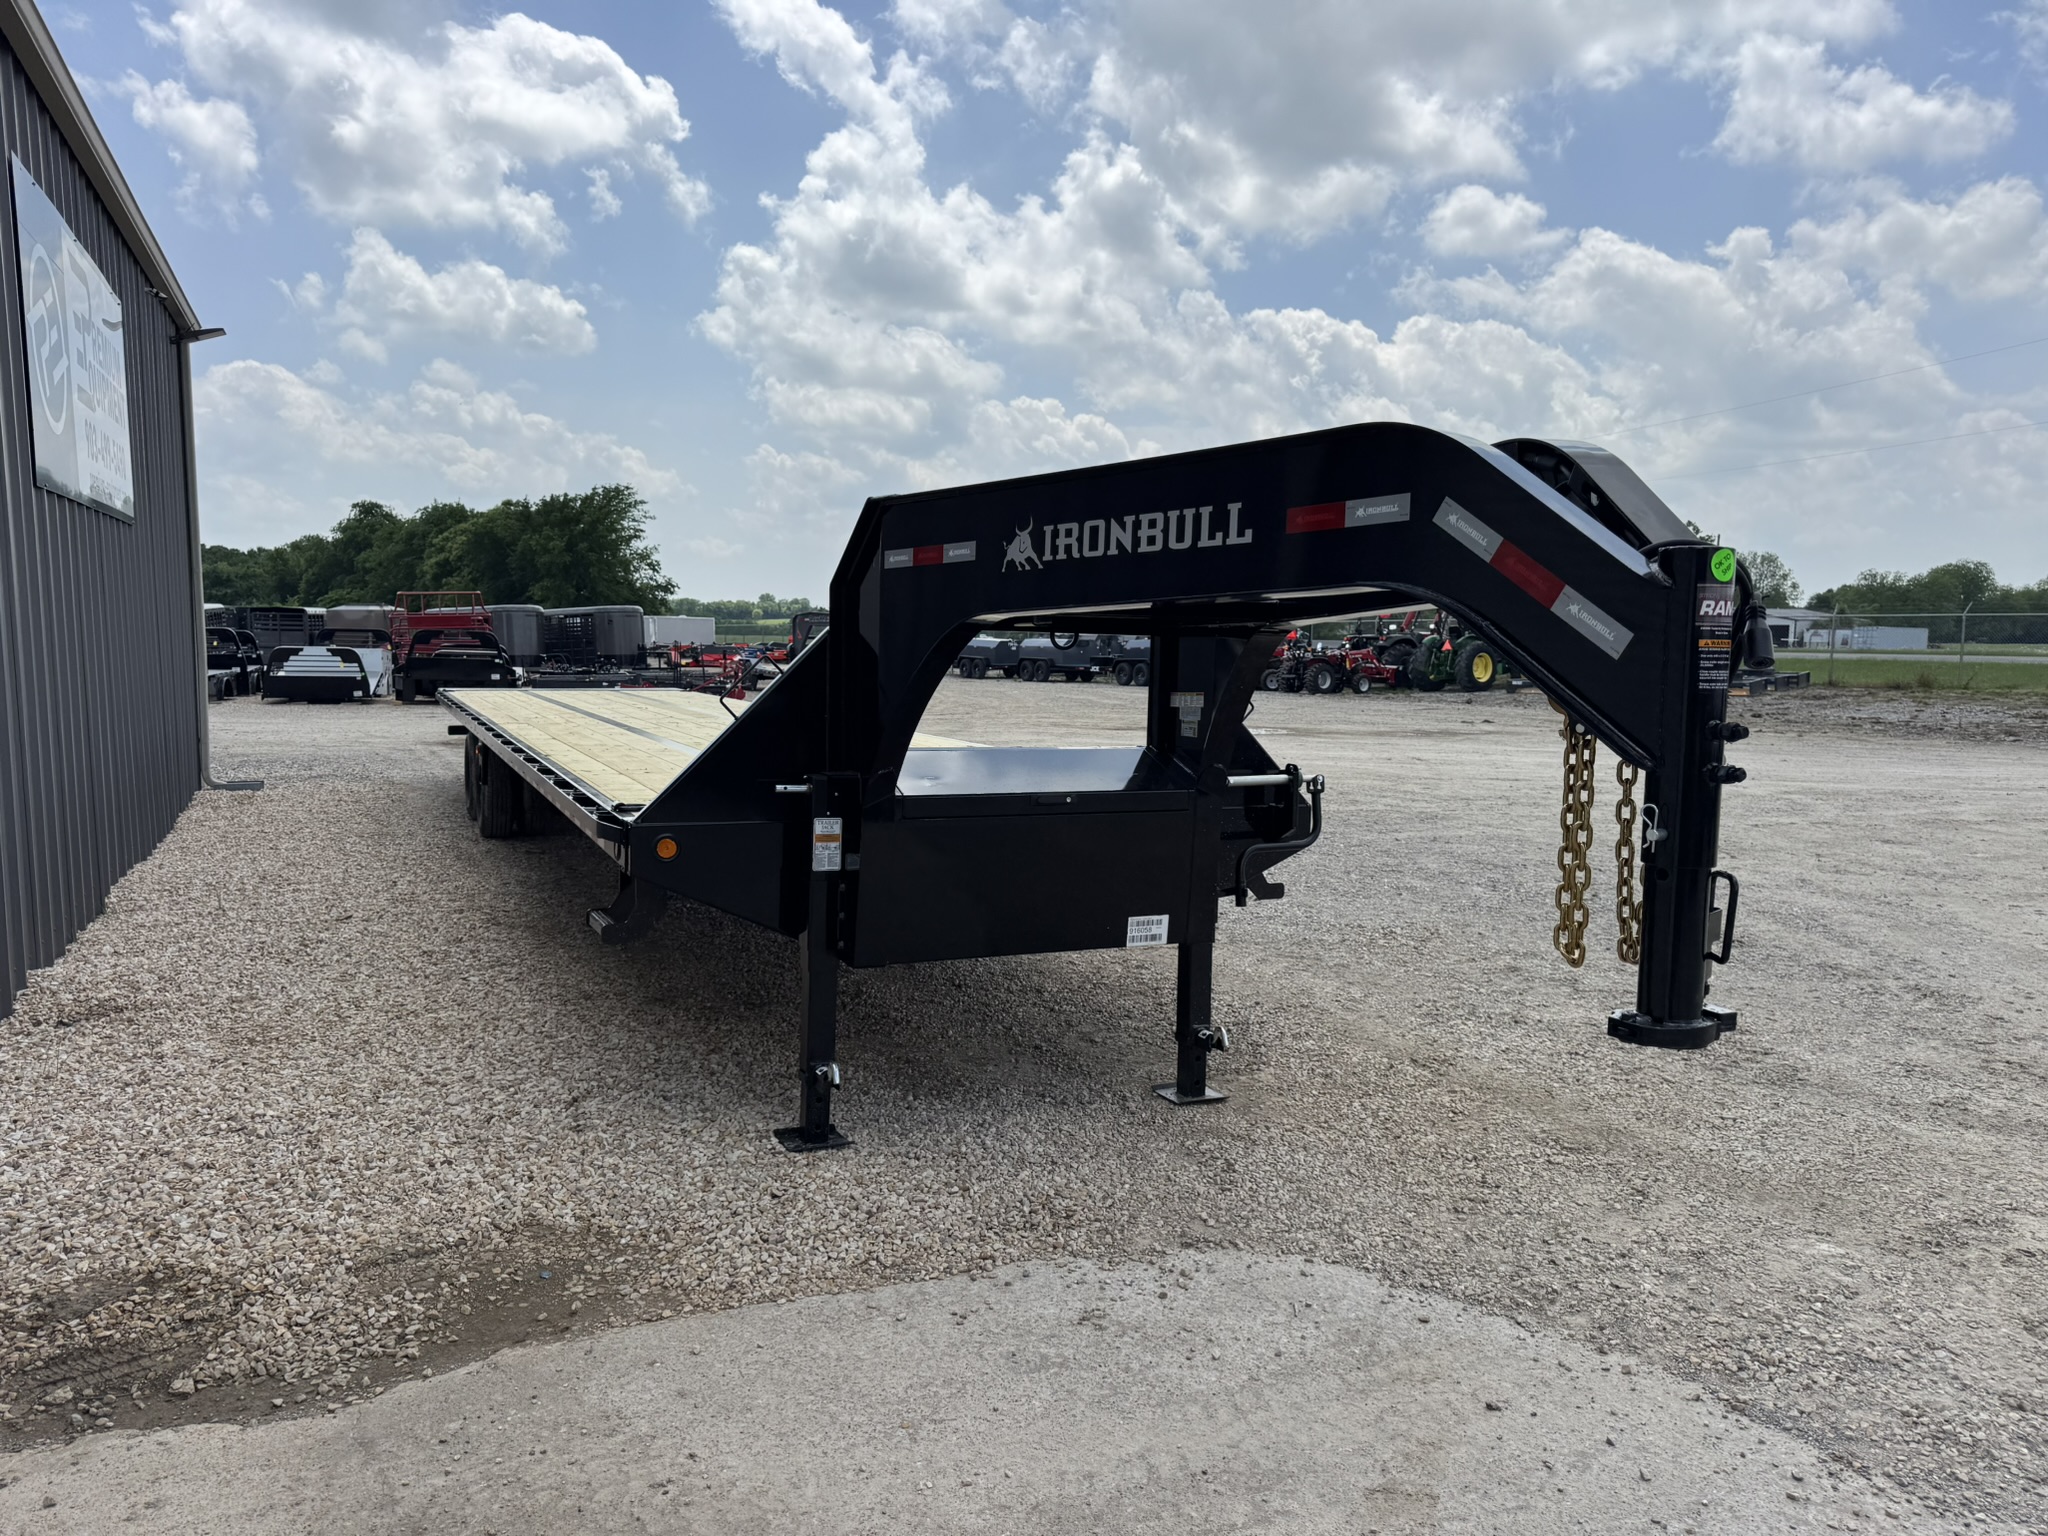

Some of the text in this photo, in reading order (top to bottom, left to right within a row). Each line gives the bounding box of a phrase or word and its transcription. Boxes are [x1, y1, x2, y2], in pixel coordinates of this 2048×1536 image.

[1042, 502, 1252, 562] IRONBULL
[1456, 518, 1488, 547] IRONBULL
[1714, 553, 1731, 570] OK TO
[1578, 609, 1616, 641] IRONBULL
